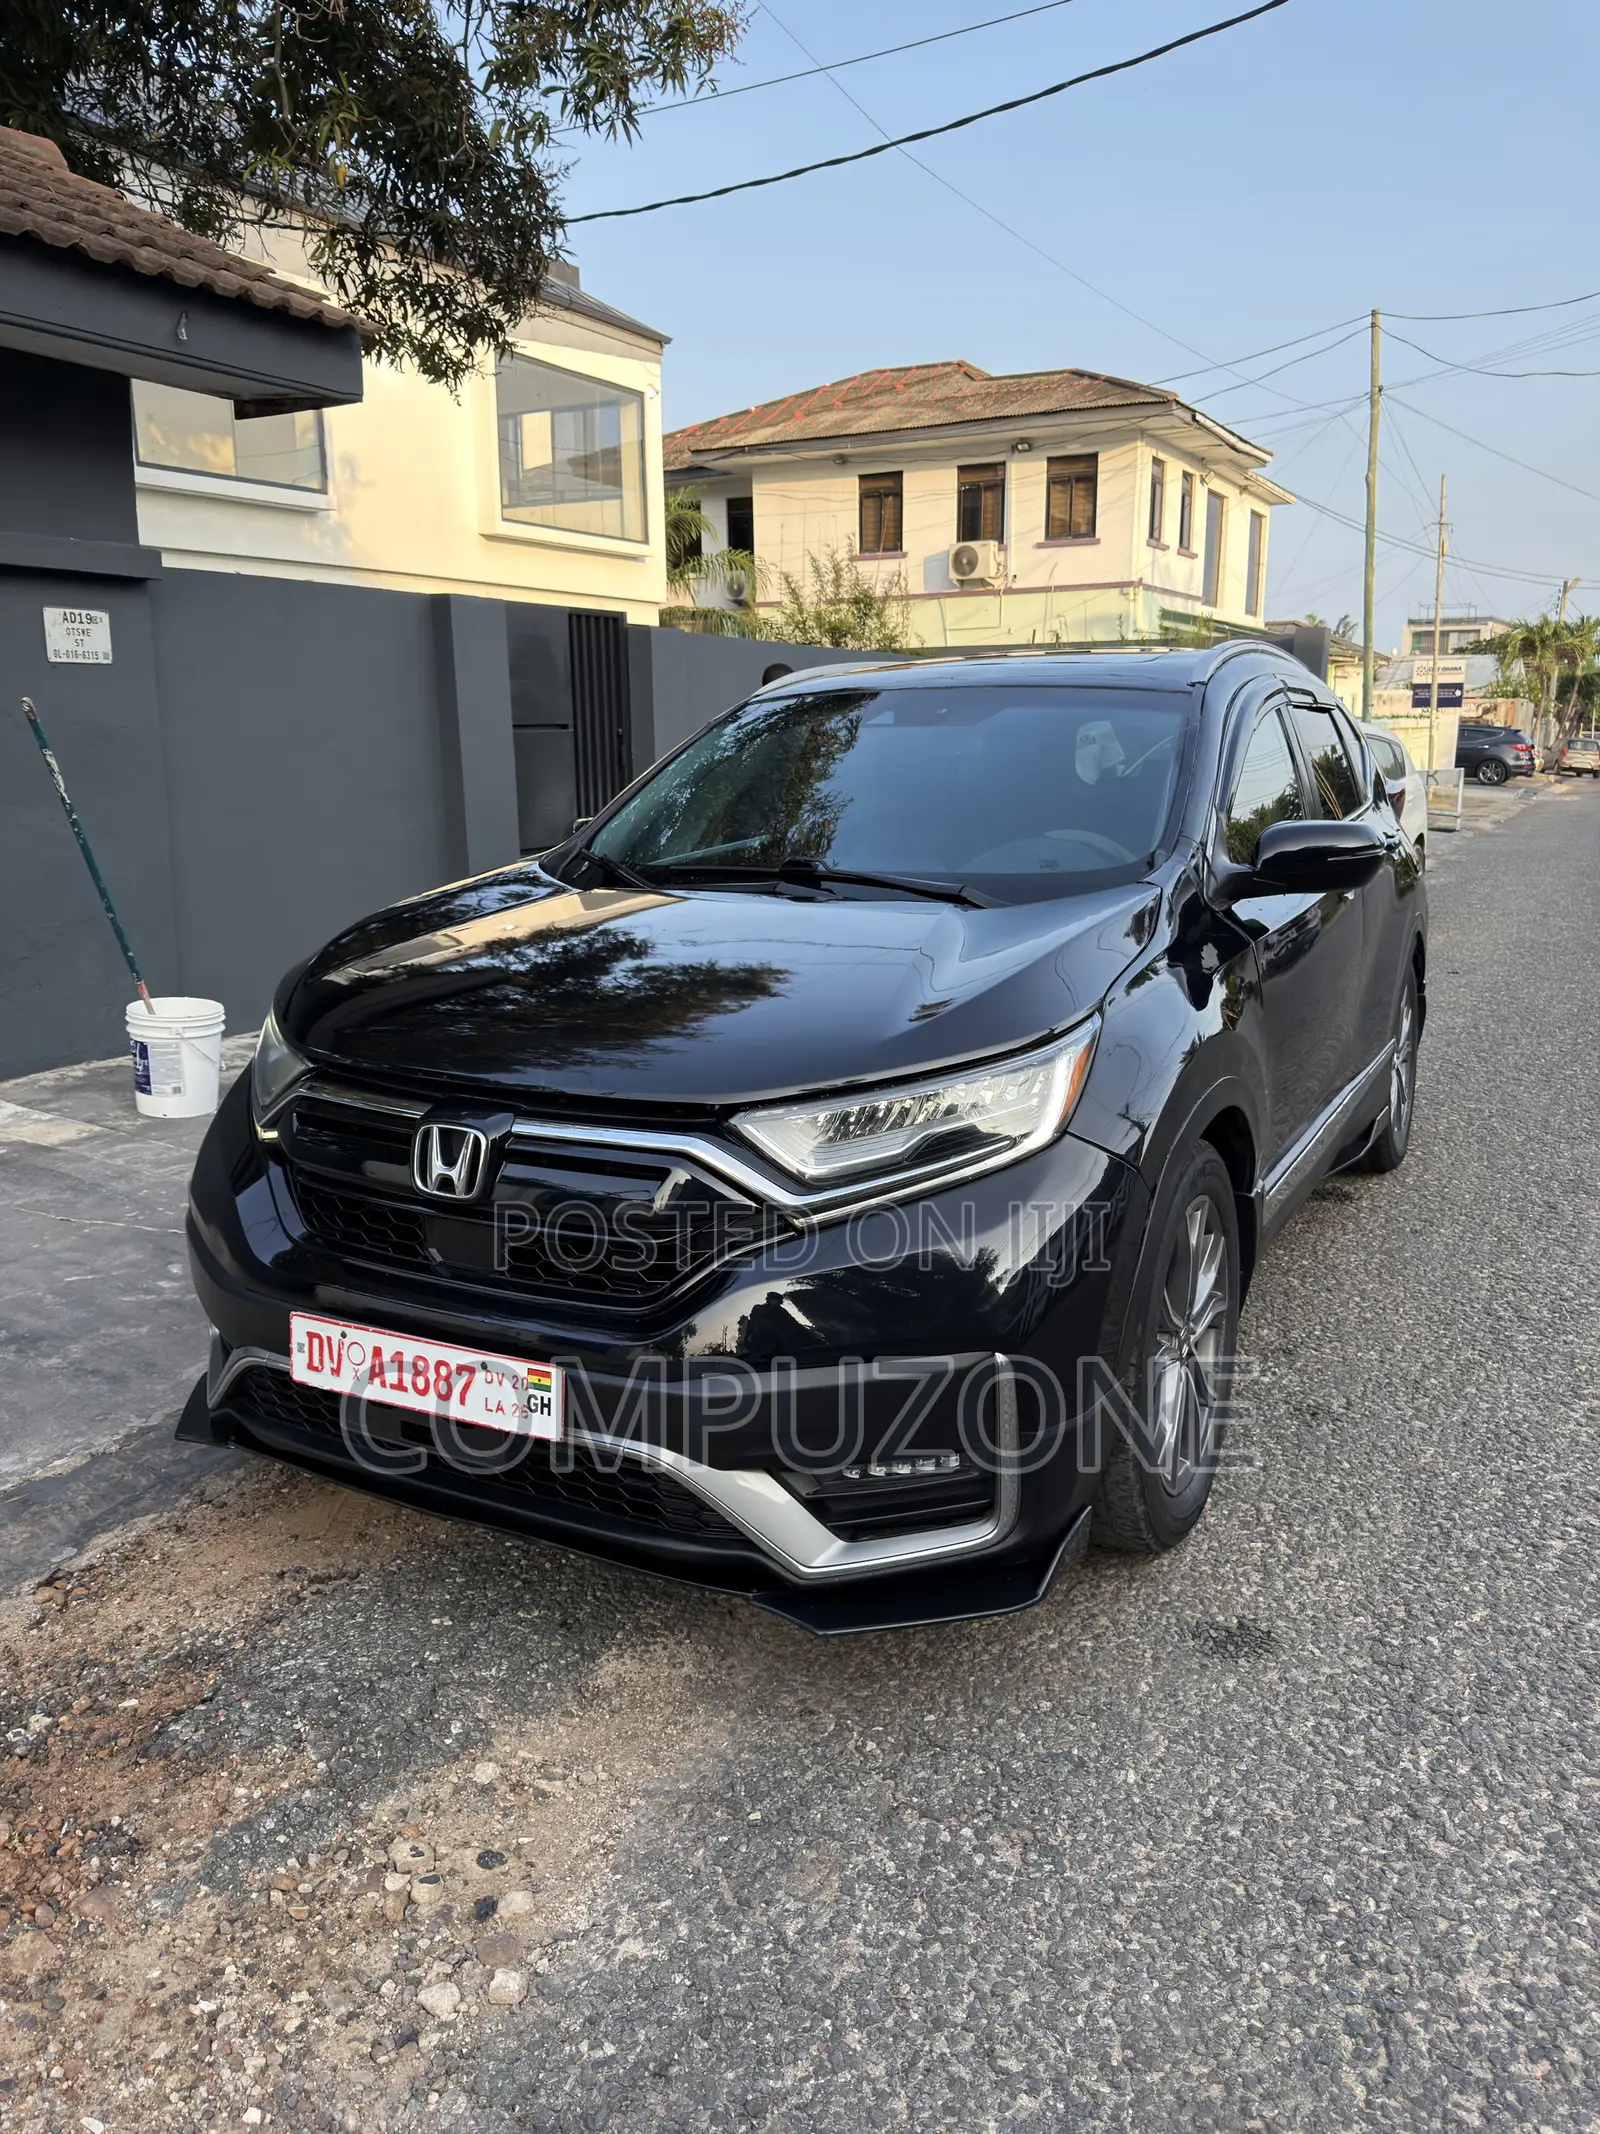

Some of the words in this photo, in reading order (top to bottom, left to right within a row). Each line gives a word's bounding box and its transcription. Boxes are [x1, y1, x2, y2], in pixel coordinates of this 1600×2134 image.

[74, 638, 85, 648] ST
[306, 1330, 344, 1377] DV
[368, 1345, 476, 1406] A1887
[484, 1369, 505, 1387] DV
[512, 1374, 529, 1391] 20
[484, 1396, 505, 1415] LA
[527, 1393, 552, 1417] GH
